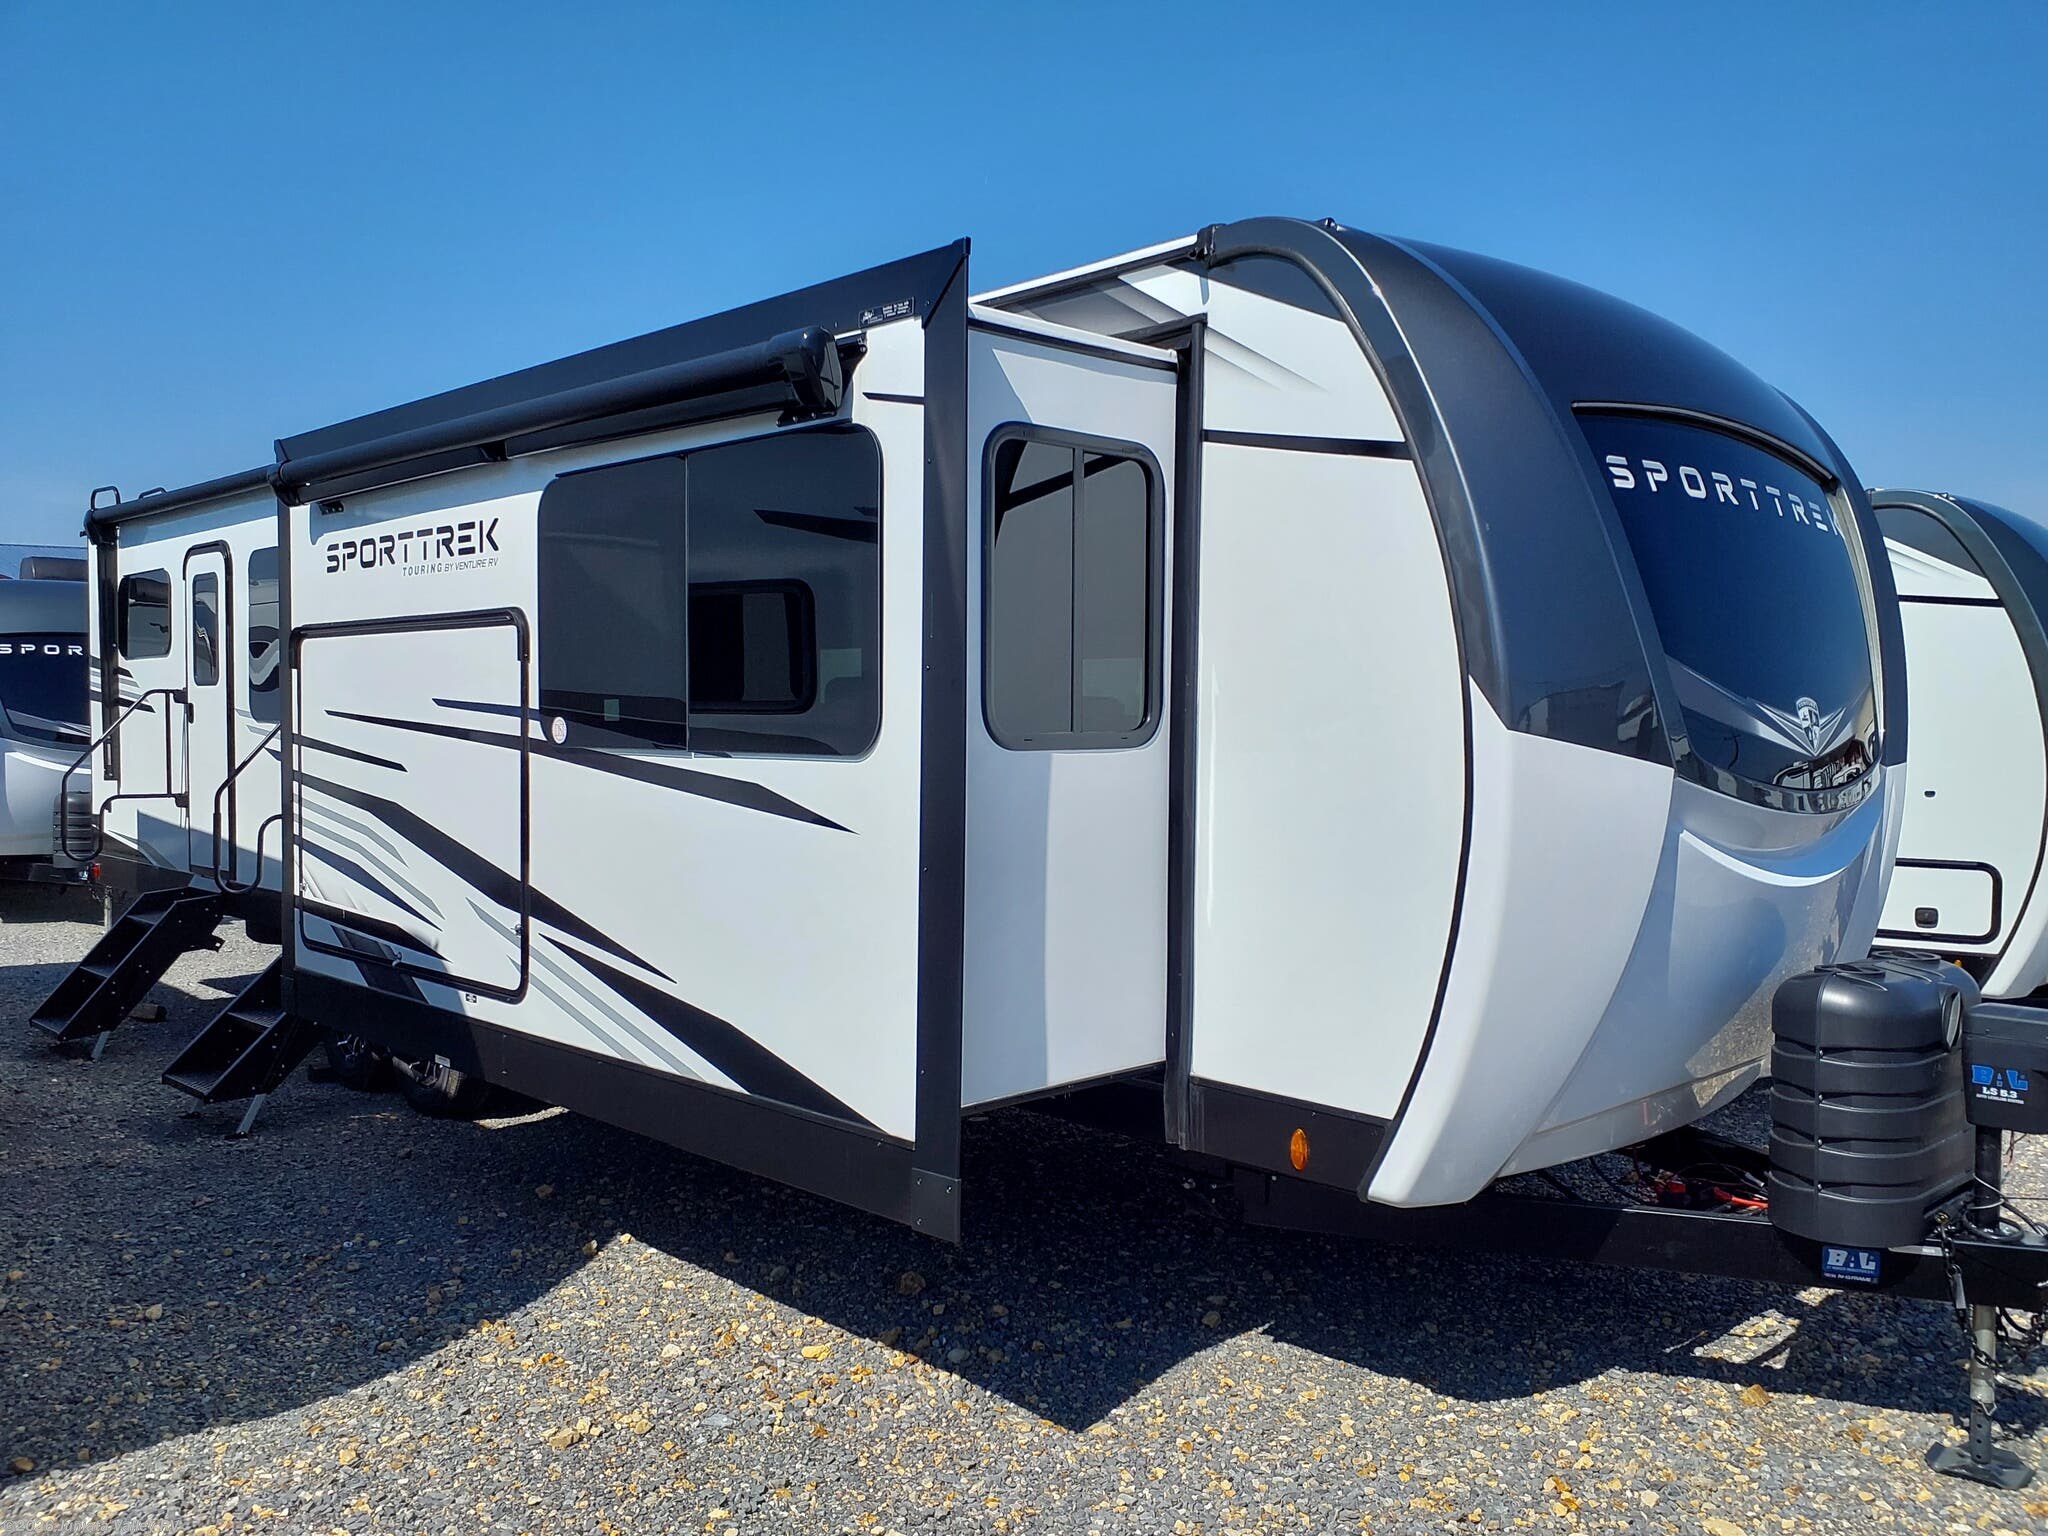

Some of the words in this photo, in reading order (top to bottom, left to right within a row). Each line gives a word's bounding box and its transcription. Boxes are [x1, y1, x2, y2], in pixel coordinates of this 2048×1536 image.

[326, 517, 499, 574] SPORTTREK
[403, 562, 443, 577] TOURING
[444, 562, 454, 573] BY
[455, 558, 487, 571] VENTURE
[488, 557, 499, 567] RV
[1972, 1064, 2029, 1091] BAL
[1982, 1086, 1998, 1096] LS
[1827, 1248, 1876, 1270] BAL
